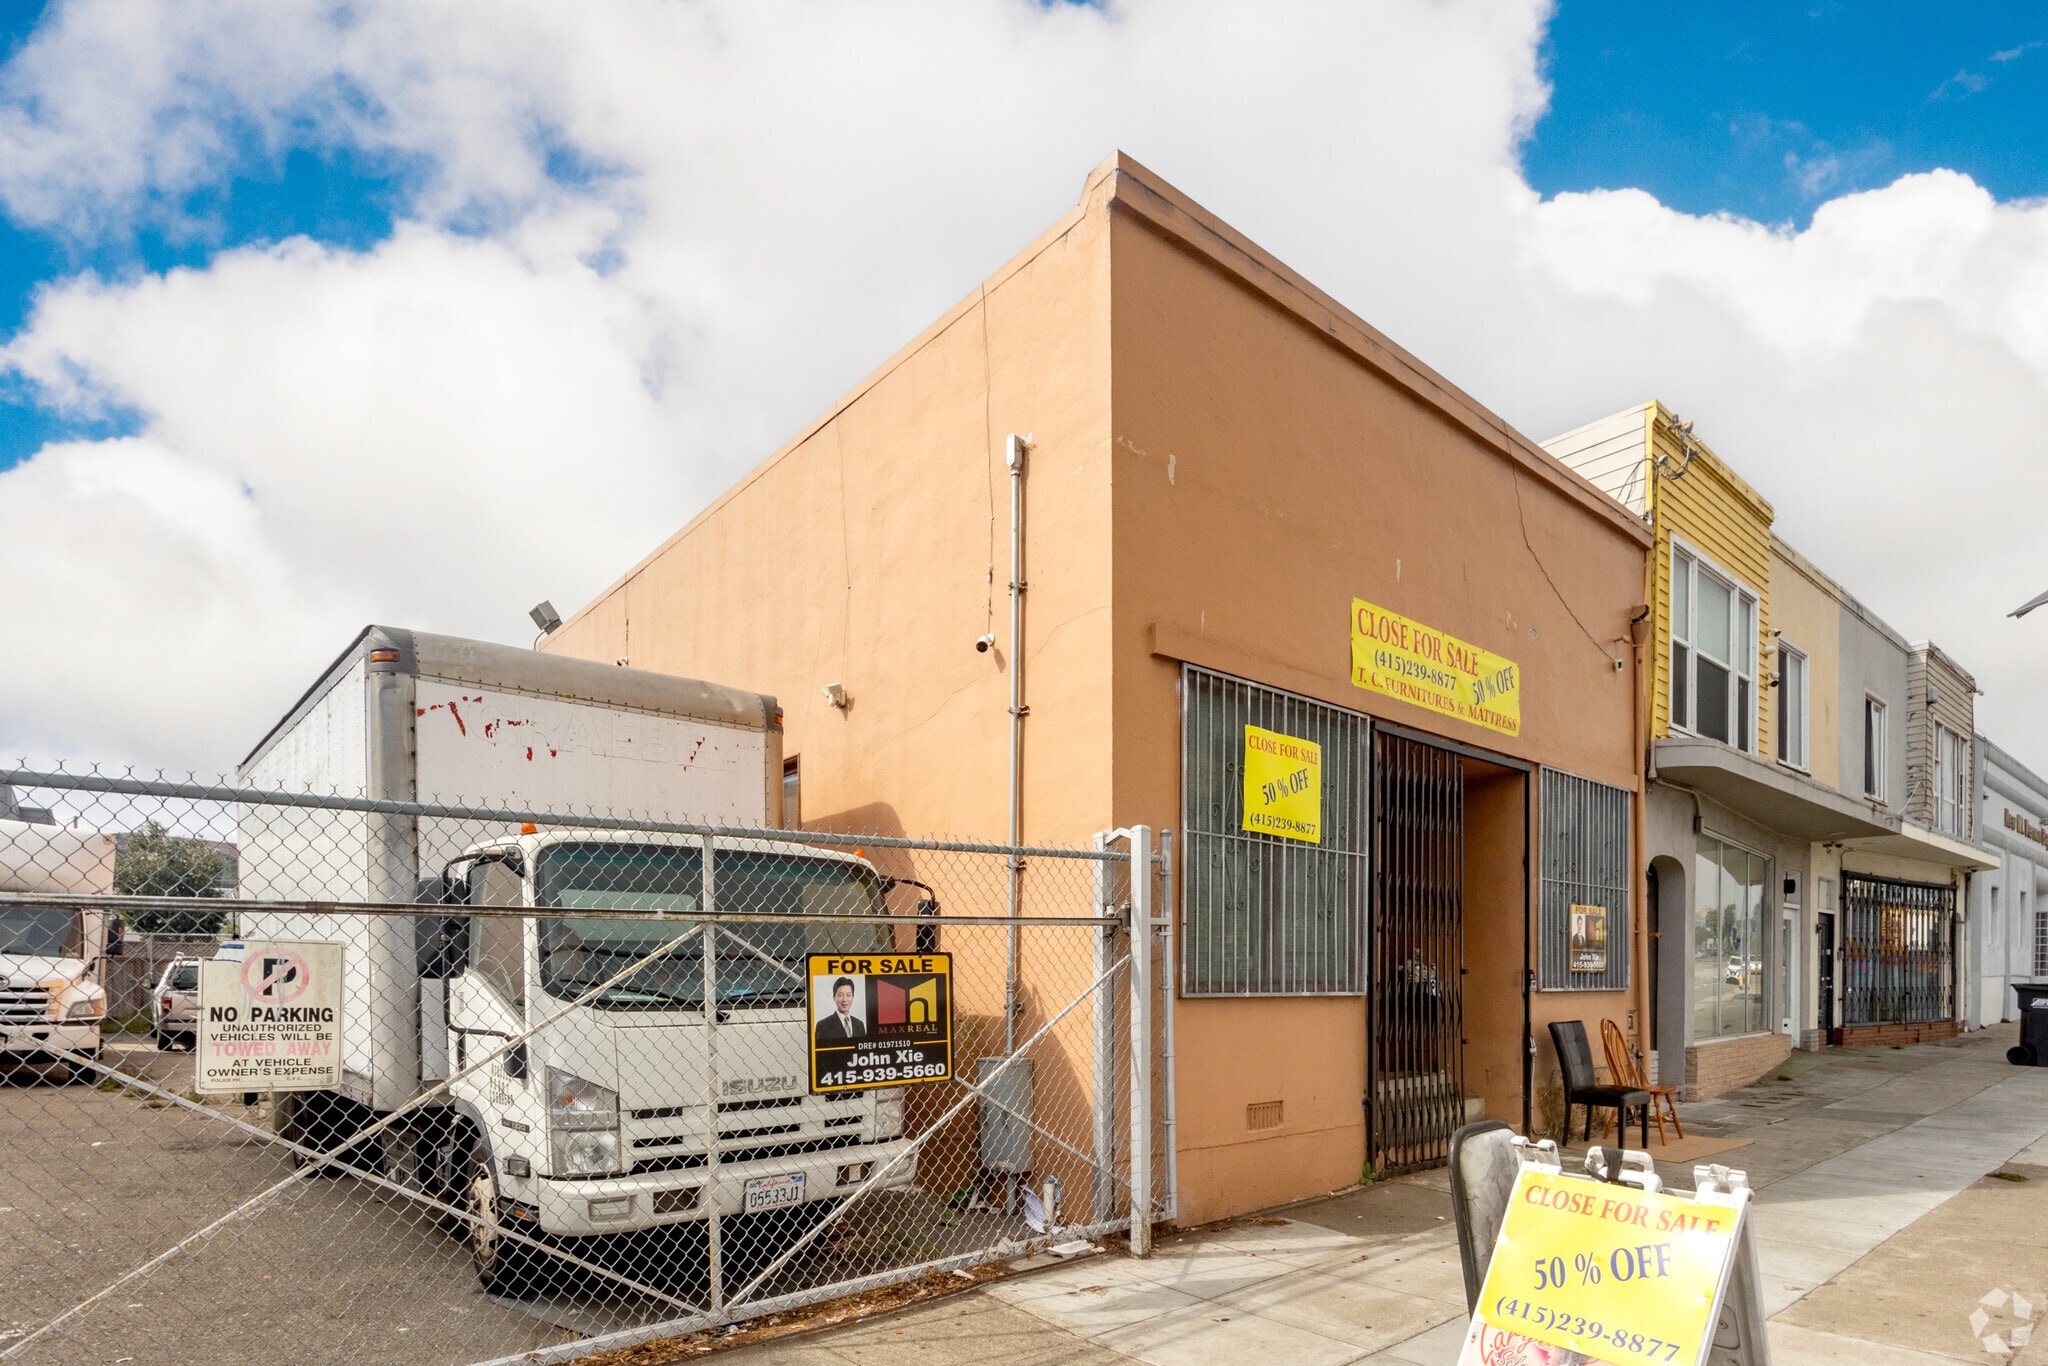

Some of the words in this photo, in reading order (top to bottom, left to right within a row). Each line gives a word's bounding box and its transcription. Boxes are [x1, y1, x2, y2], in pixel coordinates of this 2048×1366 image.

[1358, 608, 1408, 650] CLOSE
[1413, 628, 1443, 664] FOR
[1447, 643, 1478, 677] SALE
[1374, 649, 1456, 690] (415)239-8877
[1472, 679, 1485, 706] 50
[1496, 666, 1515, 694] OFF
[1358, 667, 1367, 683] T.
[1371, 673, 1383, 688] C.
[1385, 677, 1454, 712] FURNITURES
[1457, 702, 1465, 715] &
[1468, 705, 1516, 731] MATTRESS
[1249, 735, 1277, 755] CLOSE
[1280, 744, 1299, 759] FOR
[1301, 749, 1318, 765] SALE
[1262, 782, 1276, 805] 50
[1277, 777, 1288, 799] %
[1290, 768, 1309, 794] OFF
[1250, 812, 1315, 835] (415)239-8877
[1589, 907, 1602, 915] SALE
[828, 960, 872, 974] FOR
[880, 959, 933, 973] SALE
[210, 1007, 237, 1022] NO
[251, 1007, 334, 1022] PARKING
[211, 1033, 275, 1041] VEHICLES
[281, 1033, 311, 1041] WILL
[222, 1024, 322, 1032] UNAUTHORIZED
[212, 1042, 276, 1056] TOWED
[287, 1042, 332, 1056] AWAY
[858, 1042, 876, 1050] DRE#
[878, 1040, 910, 1049] 01971510
[232, 1059, 249, 1067] AT
[256, 1058, 311, 1066] VEHICLE
[847, 1052, 890, 1067] John
[895, 1049, 924, 1063] Xie
[207, 1068, 271, 1077] OWNER'S
[275, 1067, 333, 1075] EXPENSE
[821, 1063, 946, 1085] 415-939-5660
[722, 1075, 797, 1096] ISUZU
[1525, 1185, 1595, 1216] CLOSE
[1600, 1198, 1648, 1228] FOR
[1534, 1257, 1565, 1290] 50
[1574, 1251, 1601, 1286] %
[1610, 1243, 1672, 1282] OFF
[1496, 1296, 1681, 1363] (415)239-8877
